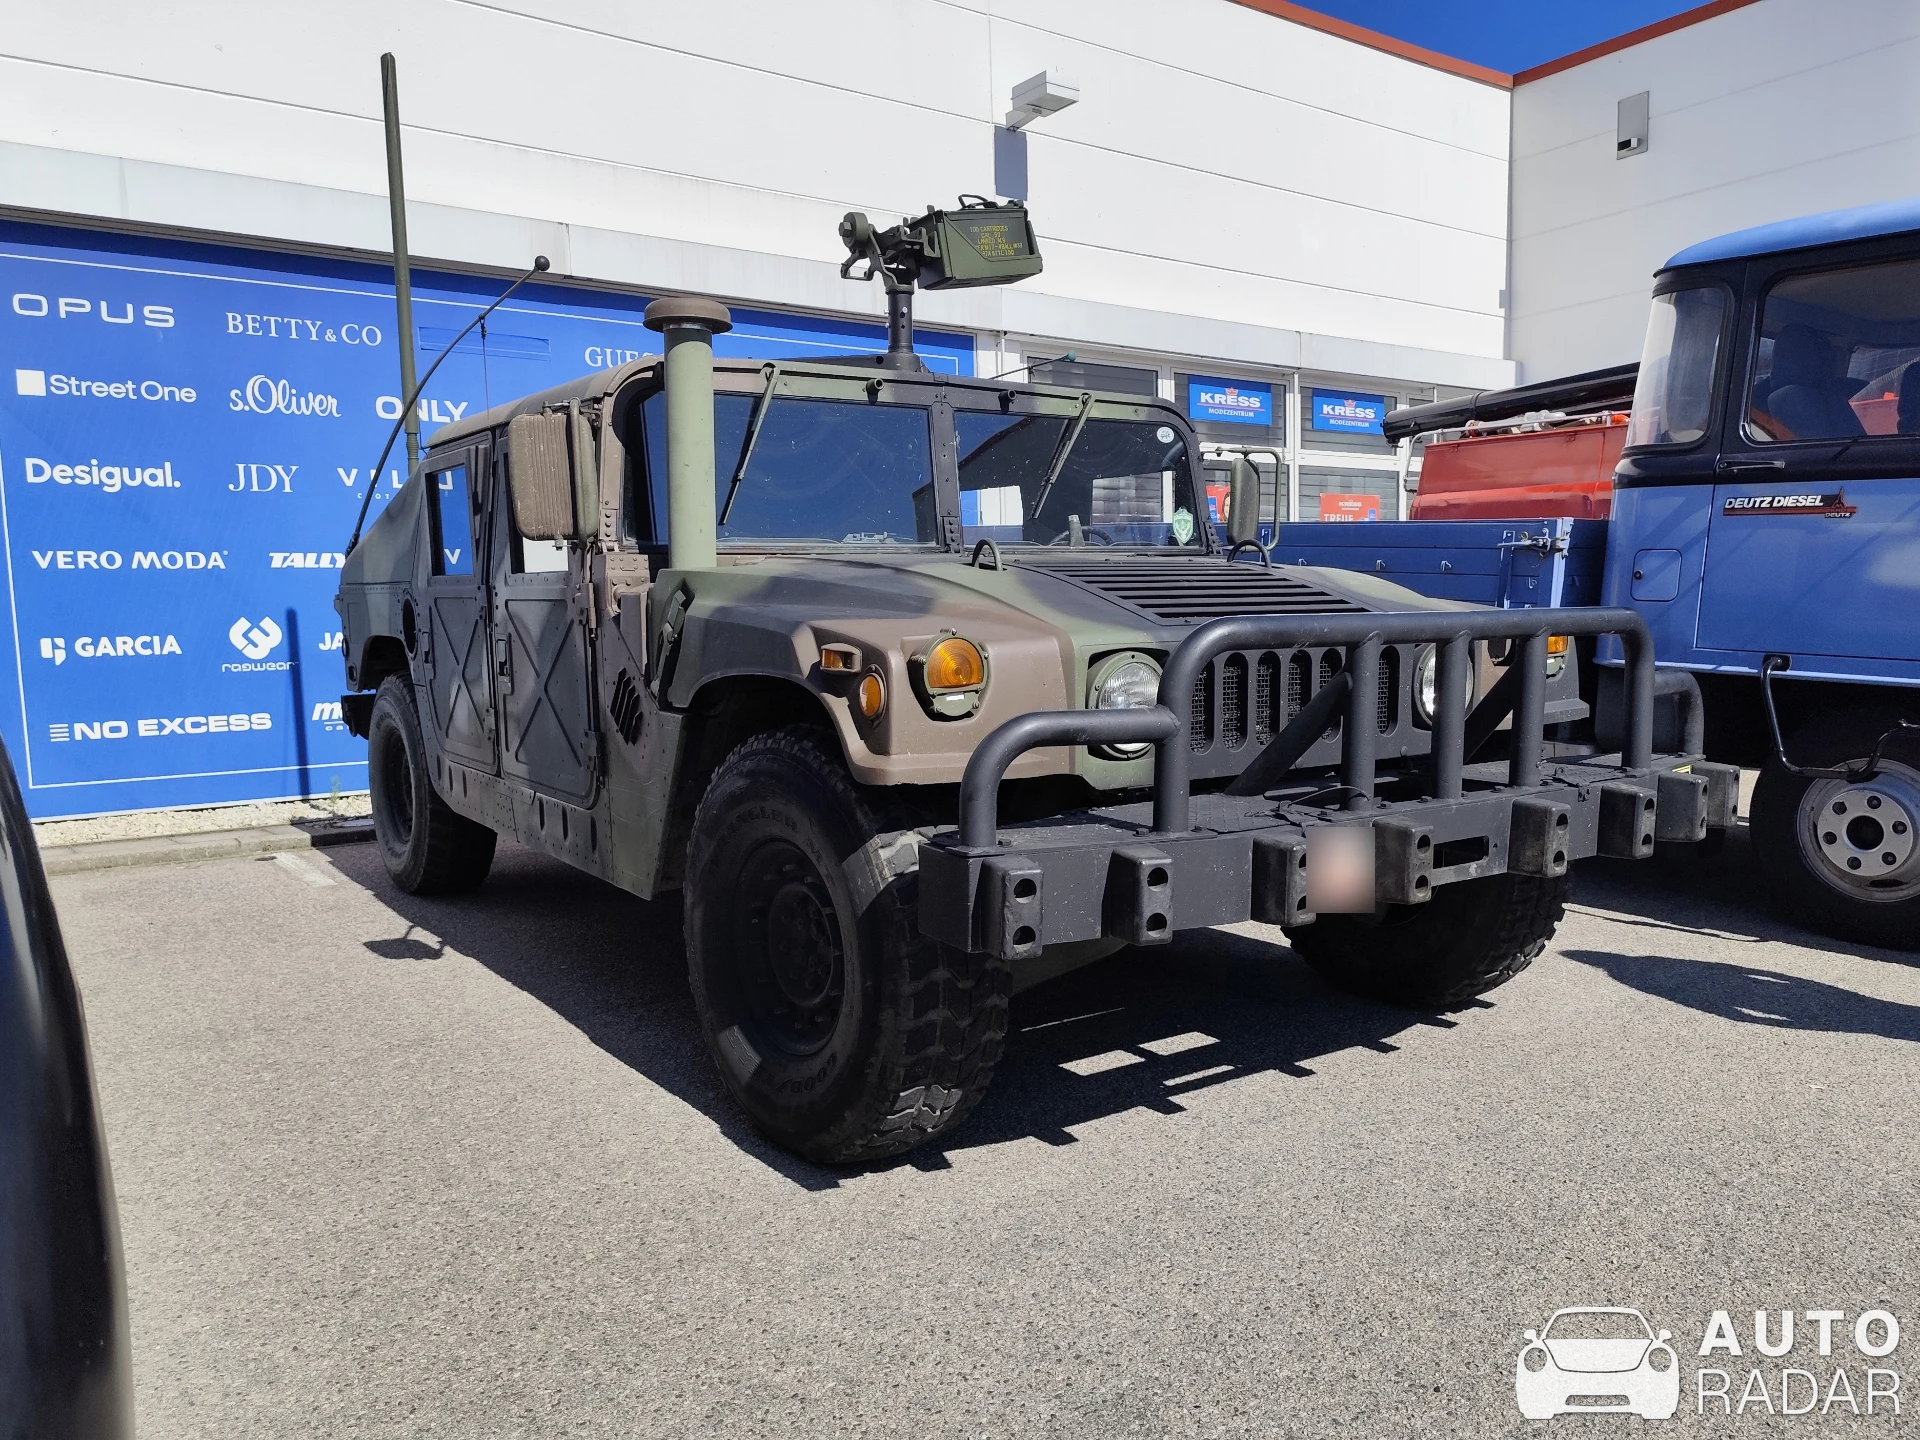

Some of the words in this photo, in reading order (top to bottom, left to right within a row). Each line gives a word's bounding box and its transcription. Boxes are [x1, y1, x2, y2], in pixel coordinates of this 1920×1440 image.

[12, 293, 175, 328] OPUS
[226, 312, 382, 346] BETTY&CO
[50, 374, 137, 400] Street
[141, 380, 197, 403] One
[229, 374, 342, 418] s.Oliver
[1200, 391, 1261, 408] KRESS
[375, 395, 469, 423] ONLY
[1208, 407, 1255, 418] MODEZENTRUM
[1322, 404, 1376, 419] KRESS
[1329, 418, 1370, 428] MODEZENTRUM
[25, 457, 181, 493] Desigual.
[228, 463, 299, 493] JDY
[1724, 496, 1772, 509] DEUTZ
[1772, 494, 1824, 508] DIESEL
[31, 550, 123, 570] VERO
[131, 551, 227, 570] MODA
[74, 634, 183, 657] GARCIA
[73, 720, 129, 741] NO
[137, 712, 273, 737] EXCESS
